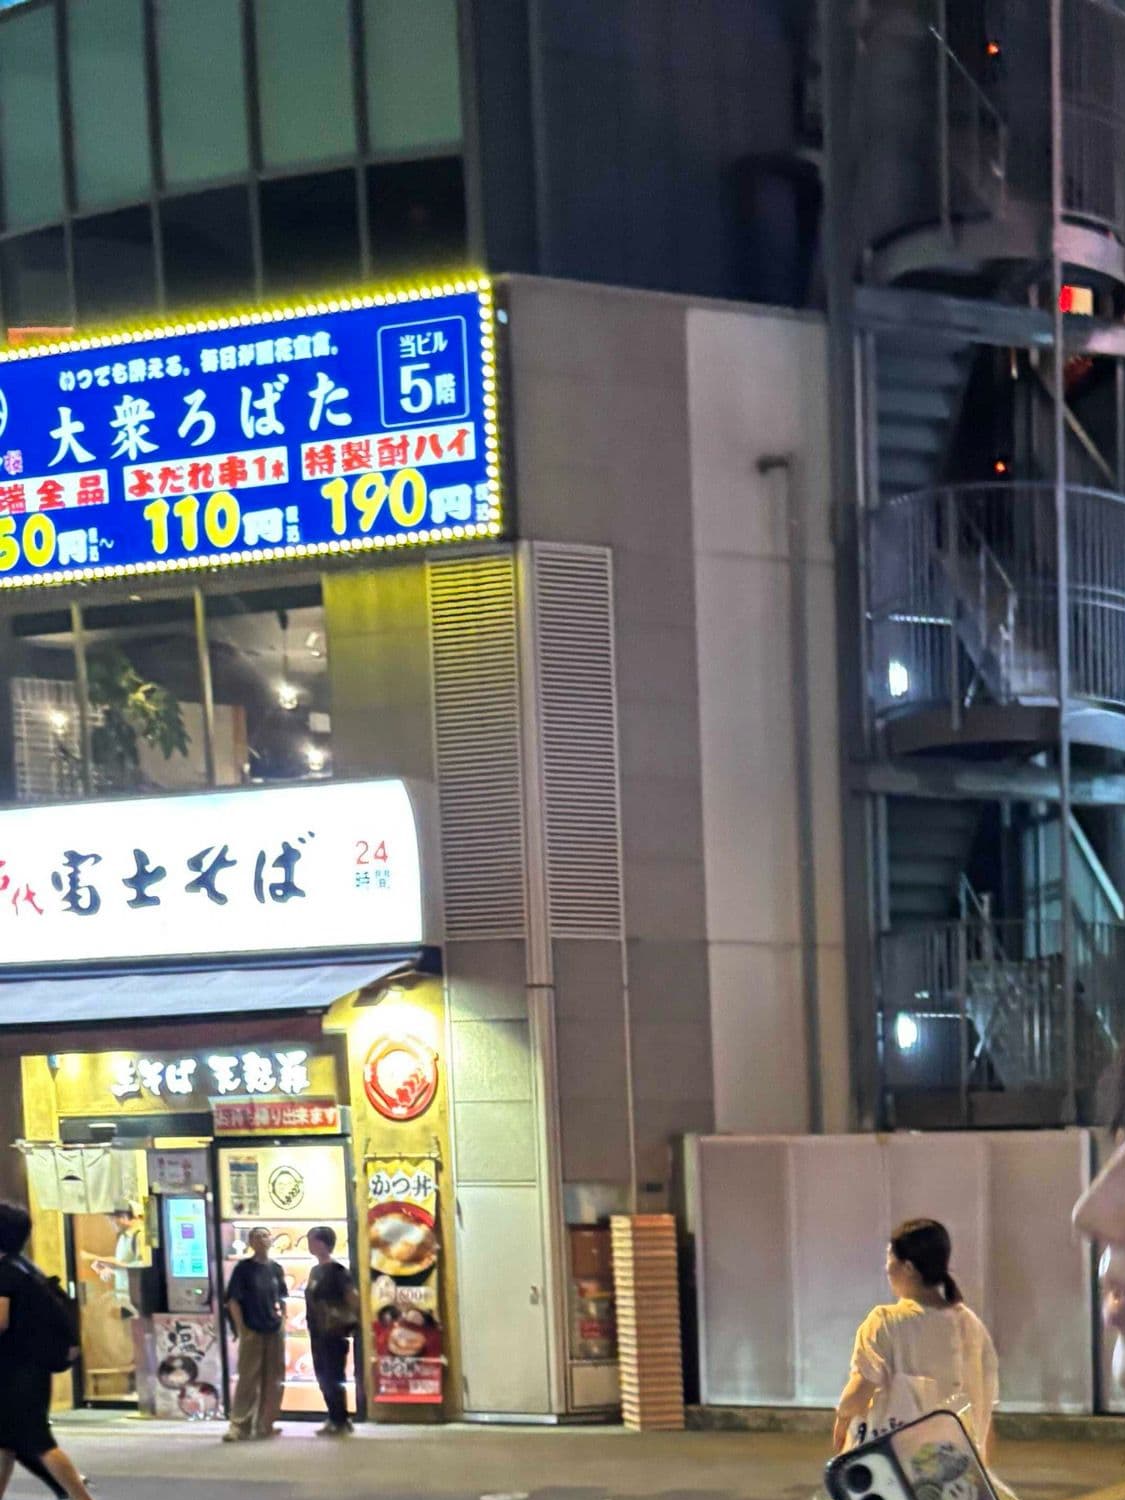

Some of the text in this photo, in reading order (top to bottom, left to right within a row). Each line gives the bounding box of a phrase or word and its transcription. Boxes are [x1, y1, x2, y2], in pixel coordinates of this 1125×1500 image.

[399, 331, 448, 358] 当ビル
[400, 363, 456, 413] 5階
[48, 372, 352, 467] 大衆ろばた
[305, 428, 470, 476] 特製酎ハイ
[51, 831, 315, 917] 富士そば
[355, 840, 389, 865] 24
[371, 1174, 432, 1197] かつ丼
